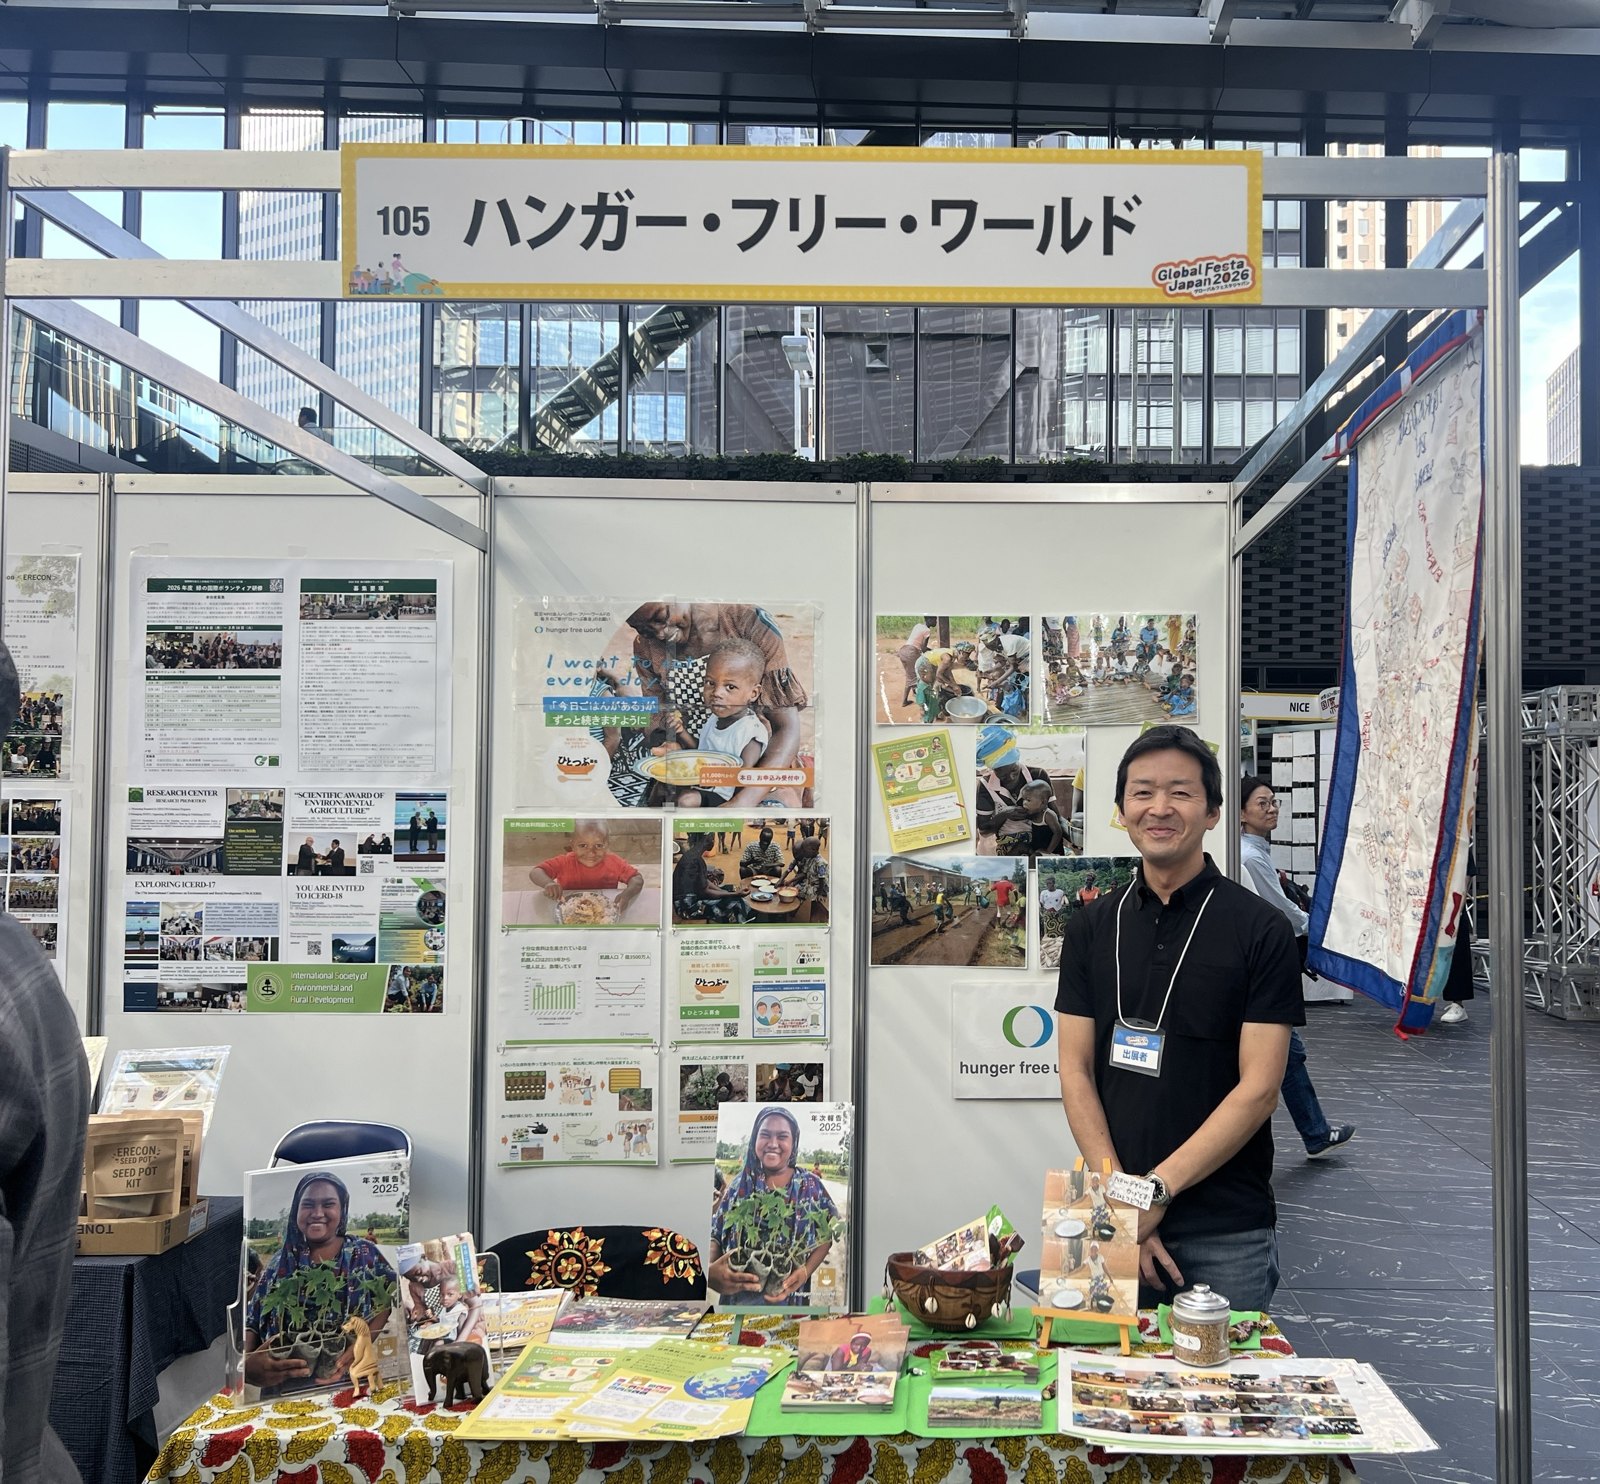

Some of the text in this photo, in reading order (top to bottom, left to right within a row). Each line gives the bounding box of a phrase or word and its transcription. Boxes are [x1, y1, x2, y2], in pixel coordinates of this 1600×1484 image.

[377, 205, 430, 236] 105
[463, 188, 1142, 256] ハンガー・フリー・ワールド
[1158, 260, 1244, 281] Global Festa
[1168, 269, 1249, 291] Japan 2026
[546, 654, 553, 669] I
[564, 656, 619, 669] want
[546, 676, 609, 687] every
[551, 700, 656, 712] 「今日ごはんがある」が
[1289, 702, 1310, 713] NICE
[552, 715, 647, 726] ずっと続きますように
[557, 756, 598, 767] ひとつぶ
[147, 789, 186, 797] RESEARCH
[291, 972, 368, 981] International Society of
[695, 977, 729, 986] ひとつぶ
[291, 984, 353, 992] Environmental and
[291, 996, 354, 1005] Rural Development
[1122, 1049, 1148, 1063] 出展者
[959, 1061, 1015, 1078] hunger
[1019, 1061, 1050, 1074] free
[819, 1123, 841, 1131] 2025
[117, 1146, 156, 1157] ERECON
[120, 1157, 137, 1165] SEED
[112, 1166, 158, 1178] SEED POT
[126, 1178, 141, 1188] KIT
[362, 1175, 399, 1184] 年次報告
[372, 1183, 399, 1194] 2025
